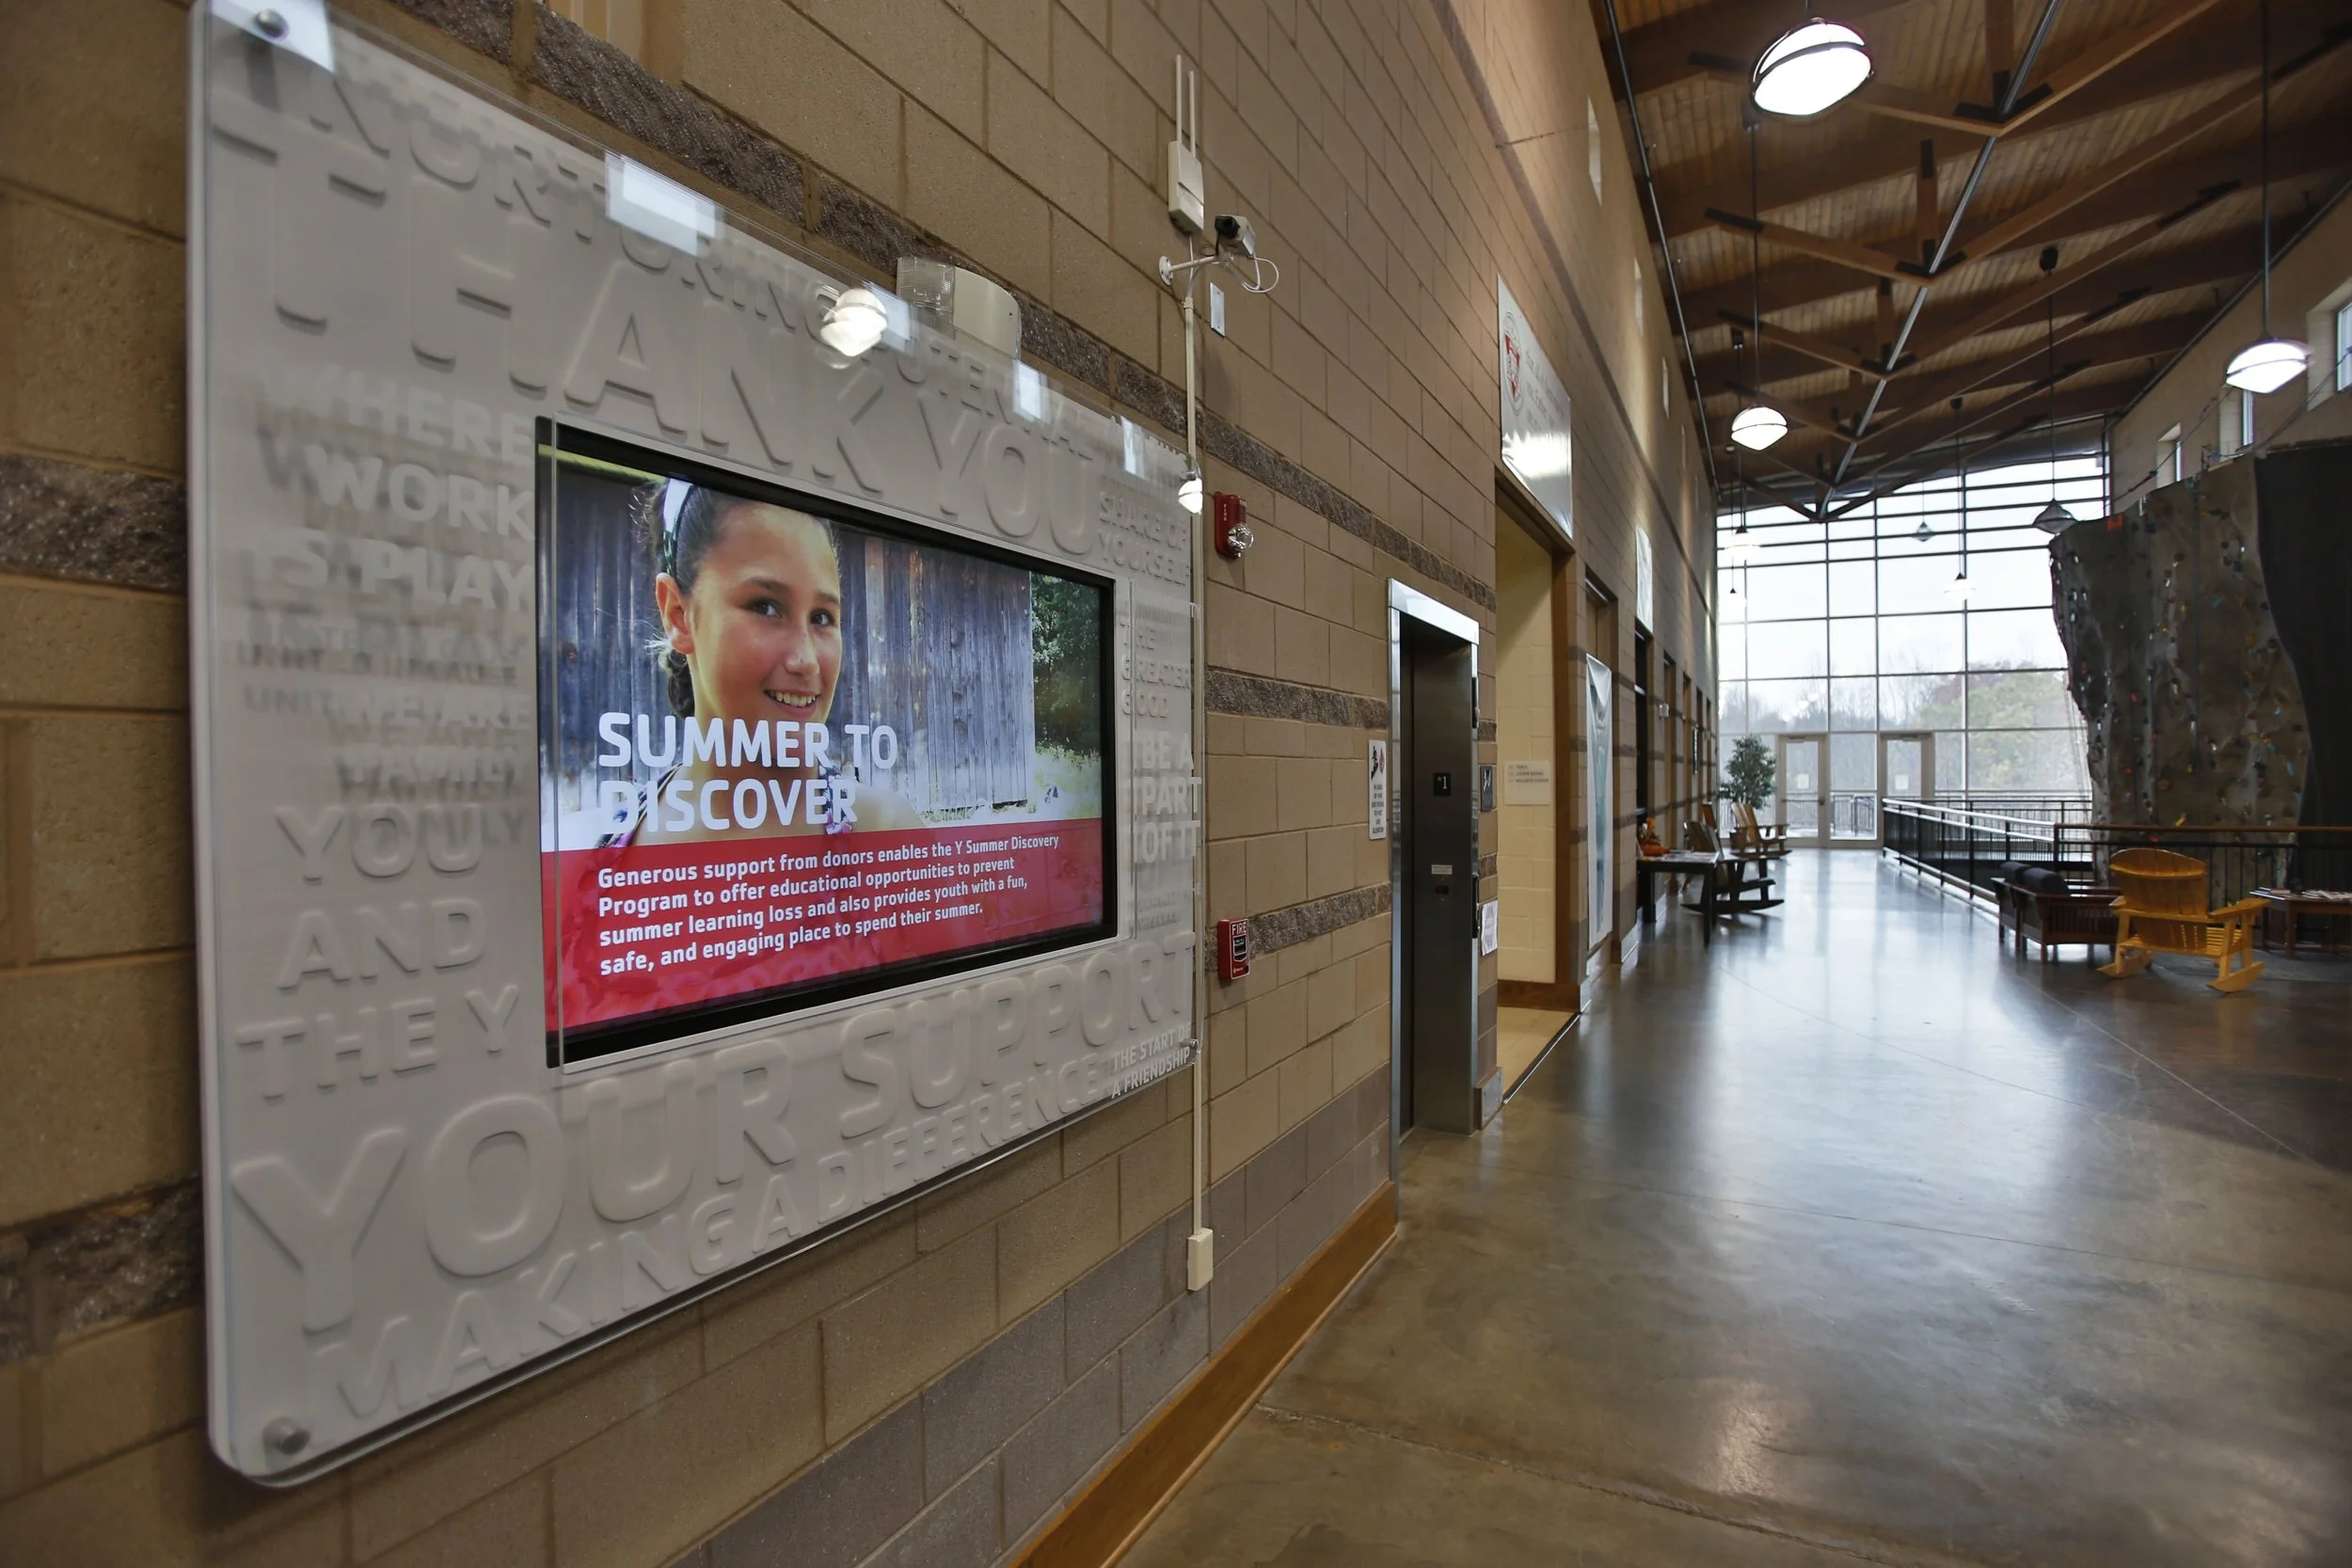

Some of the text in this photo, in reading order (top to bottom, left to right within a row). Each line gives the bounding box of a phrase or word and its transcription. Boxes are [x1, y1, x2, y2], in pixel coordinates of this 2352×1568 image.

[209, 87, 1094, 556] THANK YOU
[303, 445, 536, 542] WORK
[354, 538, 533, 614] PLAY
[437, 690, 532, 731] ARE
[598, 712, 898, 769] SUMMER TO
[1141, 731, 1195, 770] BE A
[599, 778, 858, 834] DISCOVER
[1141, 777, 1201, 816] PART
[275, 802, 483, 881] YOU
[598, 835, 1059, 888] Generous support from donors enables the Y Summer Discovery
[1141, 821, 1172, 863] OF
[599, 857, 1014, 918] Program to offer educational opportunities to prevent
[600, 877, 1027, 946] summer learning loss and also provides youth with a fun,
[278, 898, 485, 990] AND
[600, 903, 982, 975] safe, and engaging place to spend their summer.
[1232, 922, 1247, 936] FIRE
[236, 984, 519, 1100] THE Y
[1112, 1022, 1191, 1071] THE START OF
[1111, 1046, 1191, 1100] A FRIENDSHIP
[230, 931, 1195, 1336] YOUR SUPPORT
[309, 1052, 1103, 1418] MAKING A DIFFERENCE
